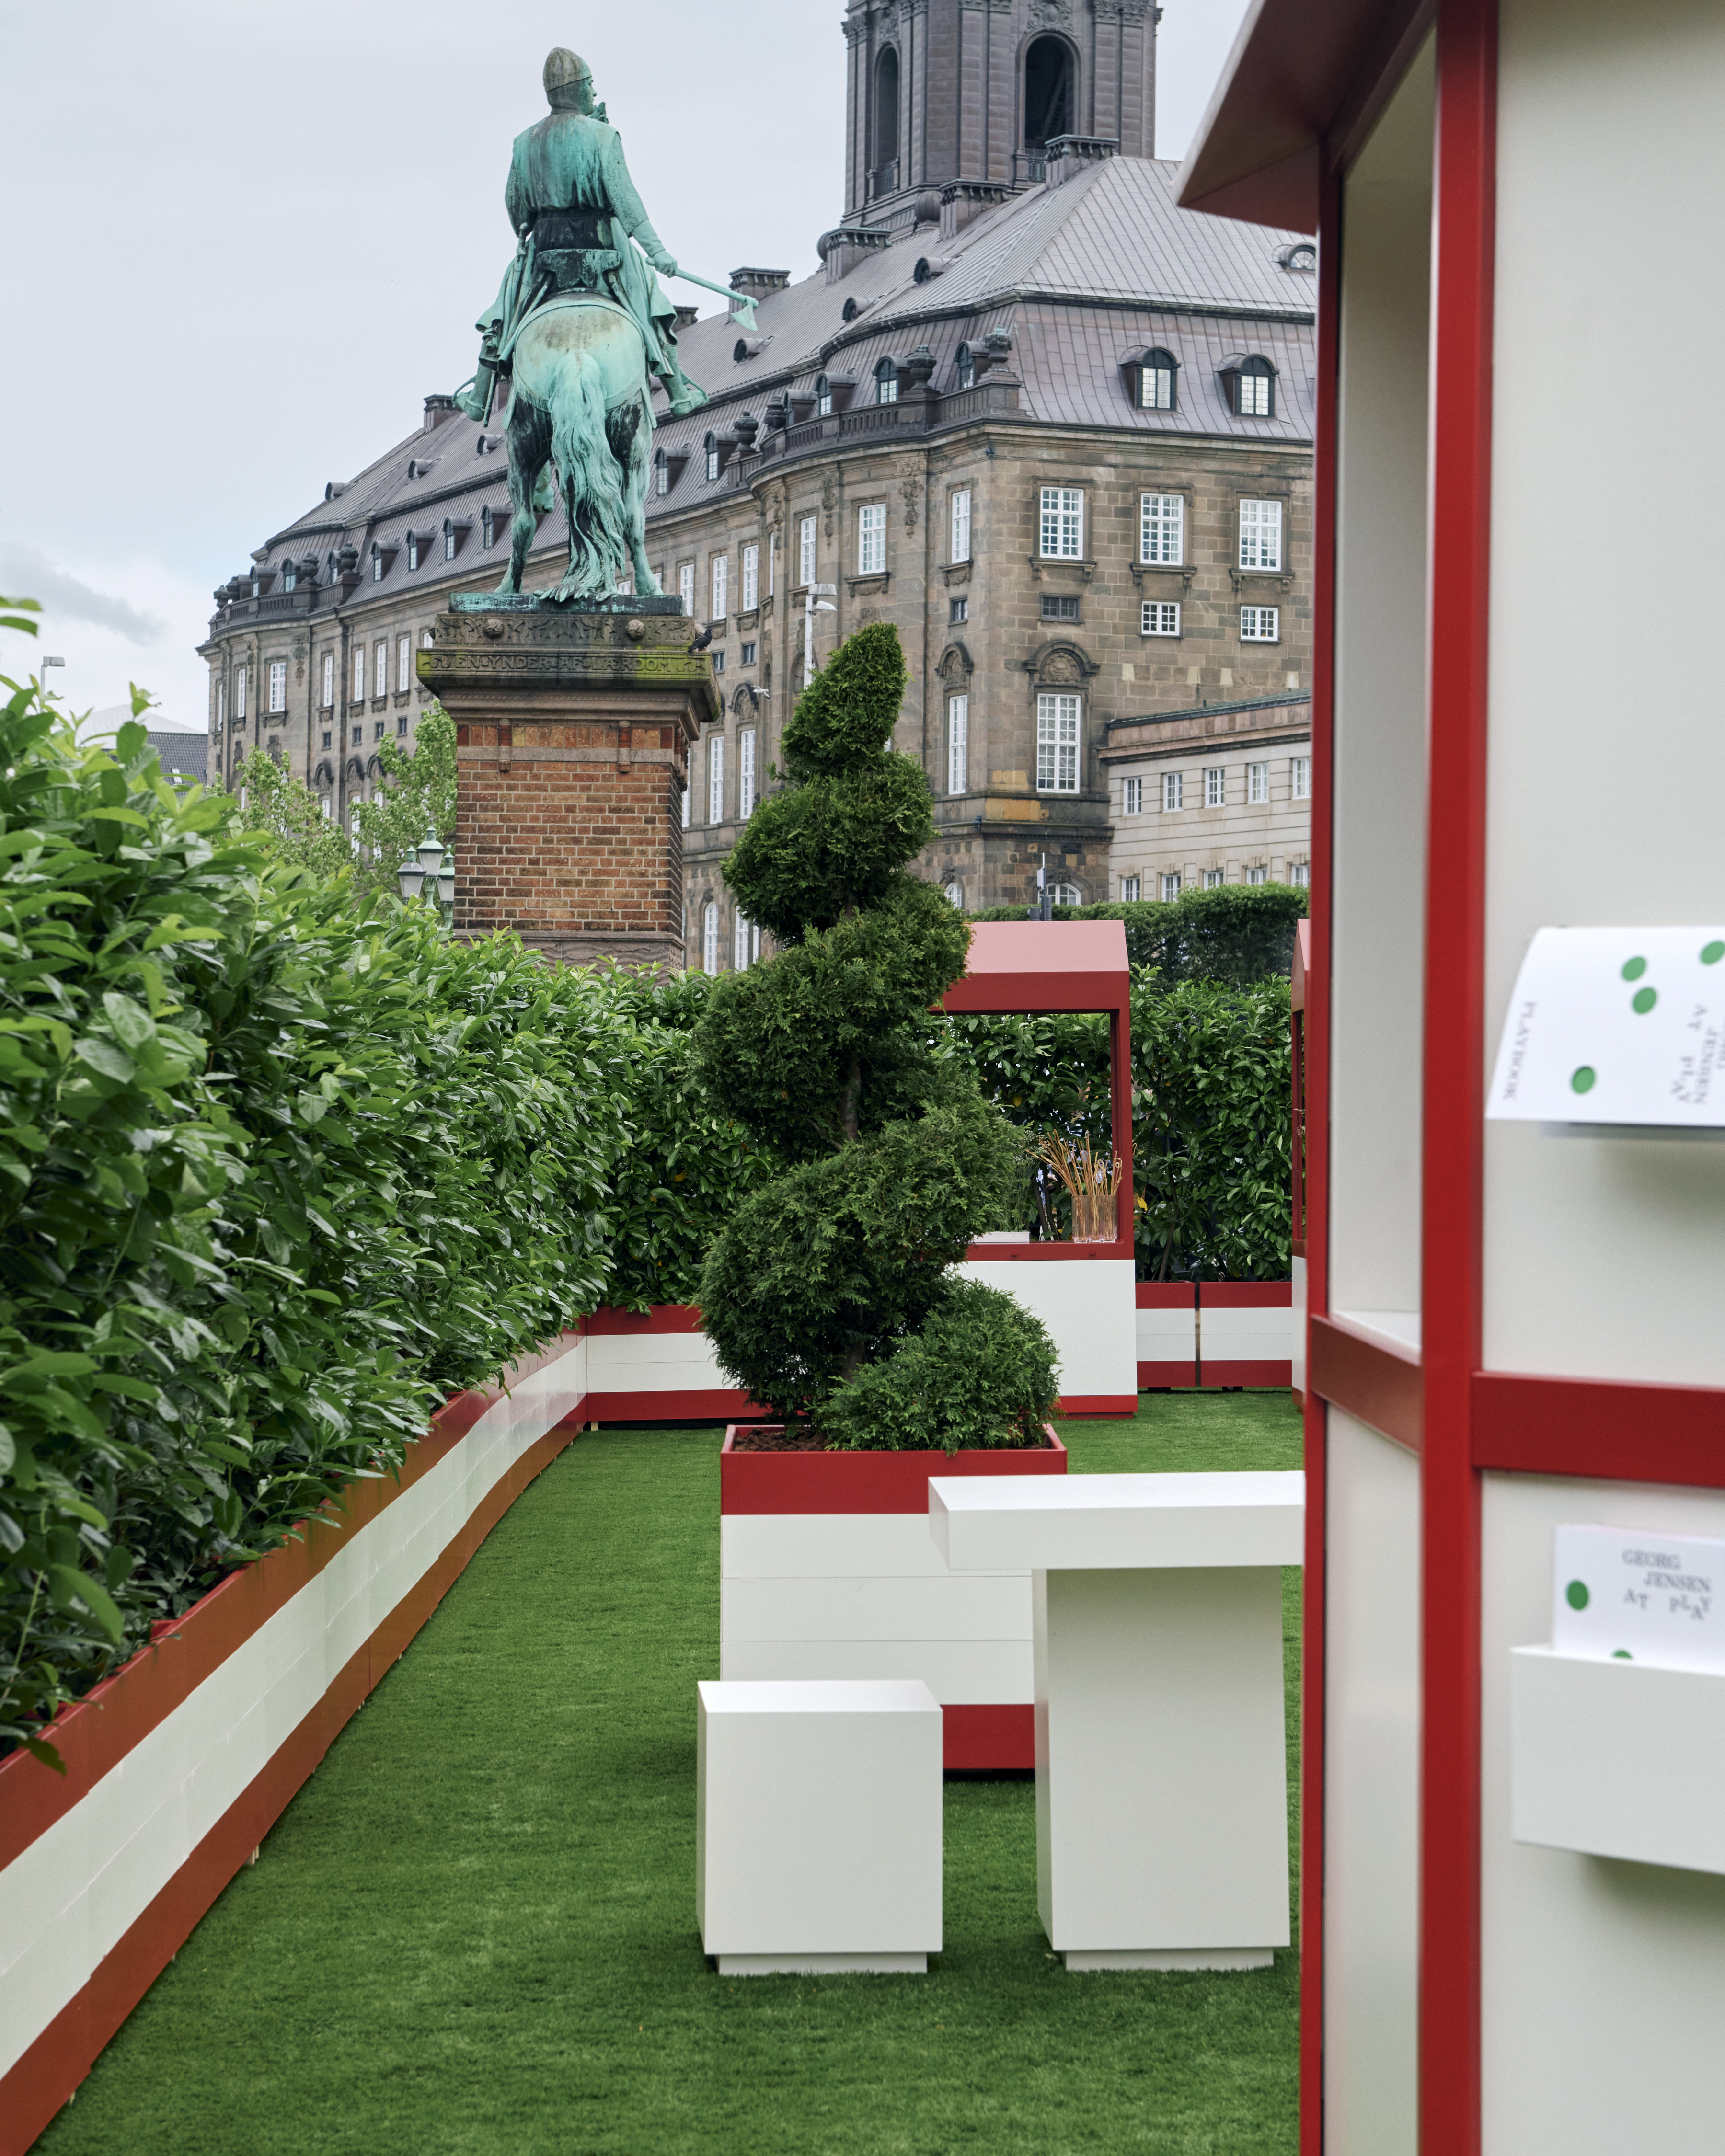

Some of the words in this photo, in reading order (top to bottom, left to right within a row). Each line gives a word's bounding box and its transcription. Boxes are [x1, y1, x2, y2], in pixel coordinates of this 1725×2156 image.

[455, 655, 480, 669] EN
[488, 655, 550, 670] YNDER
[558, 655, 583, 671] AF
[592, 656, 671, 672] LÆRDOM
[1686, 1004, 1709, 1031] AT
[1503, 1001, 1536, 1099] PLAYBOOK
[1670, 1055, 1696, 1103] PLAY
[1622, 1548, 1680, 1570] GEORG
[1643, 1571, 1712, 1593] JENSEN
[1623, 1587, 1648, 1609] AT
[1669, 1593, 1711, 1621] PLAY
